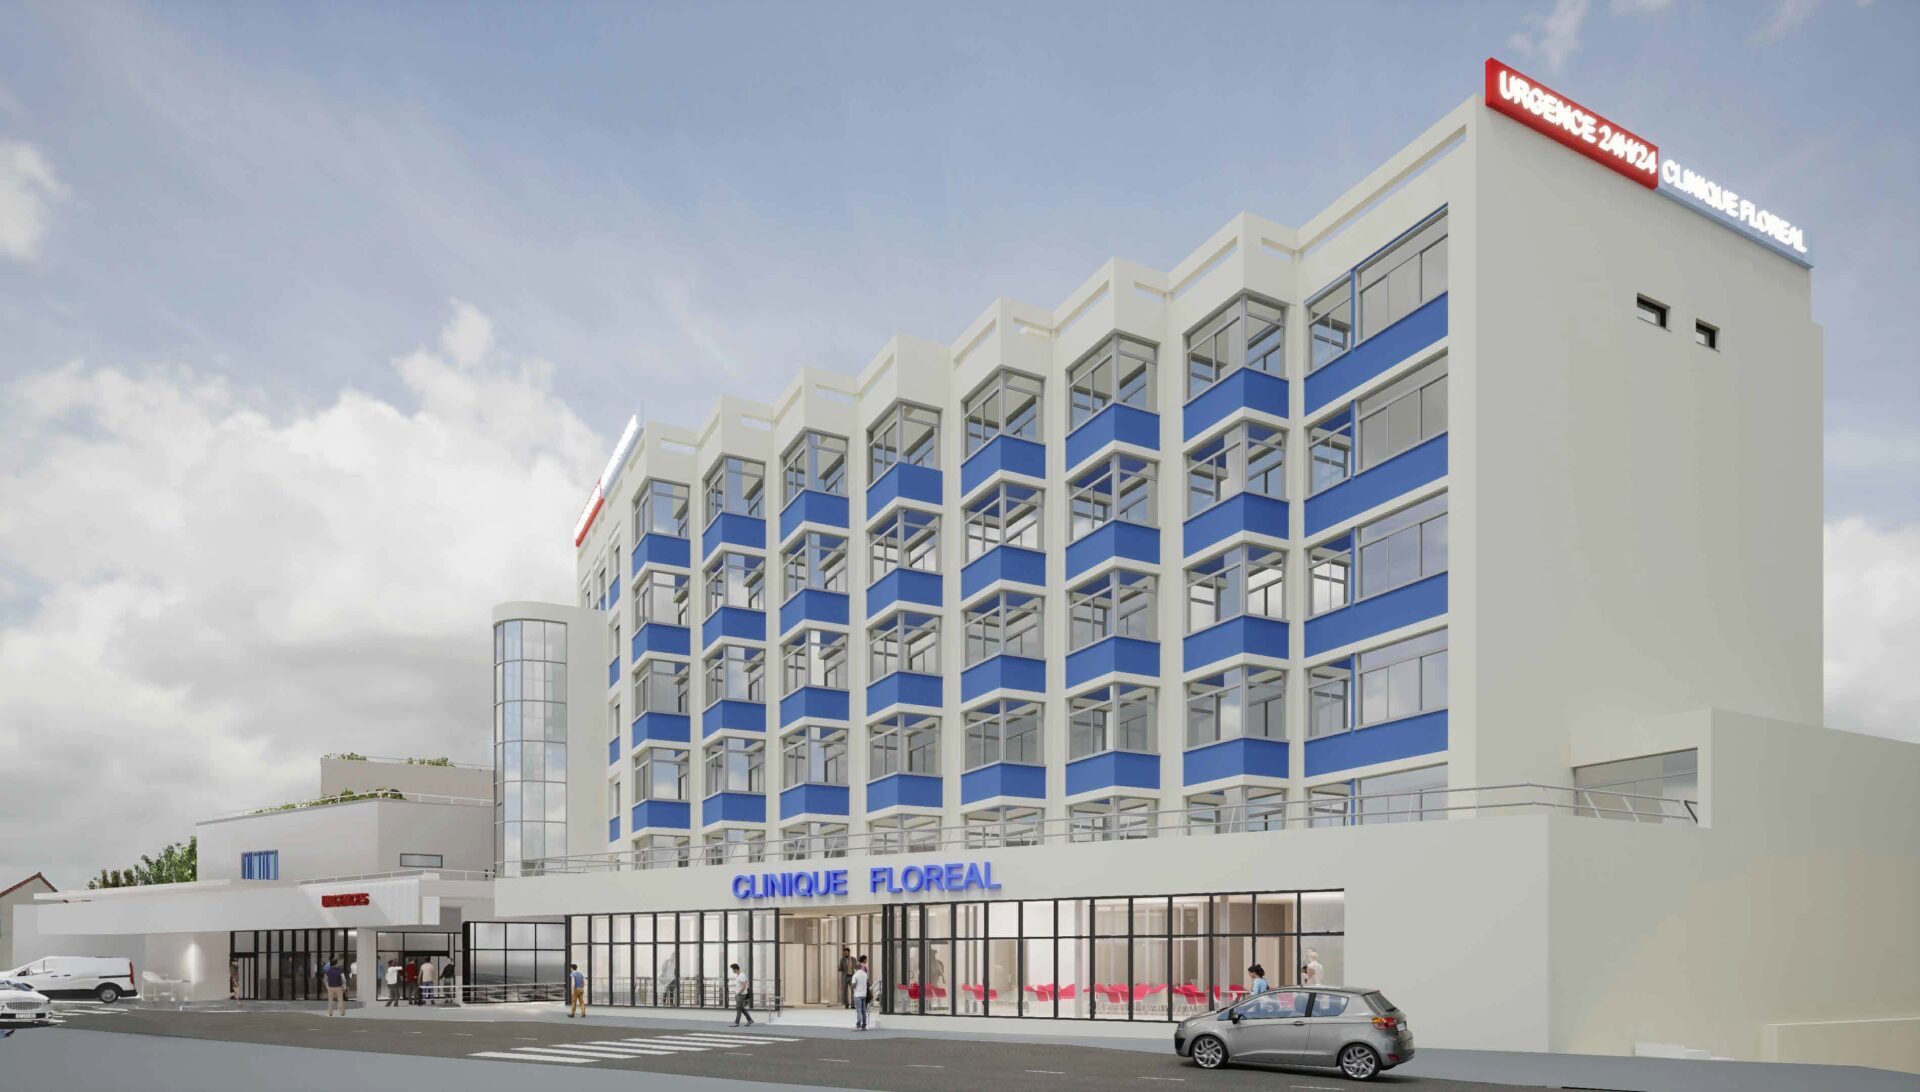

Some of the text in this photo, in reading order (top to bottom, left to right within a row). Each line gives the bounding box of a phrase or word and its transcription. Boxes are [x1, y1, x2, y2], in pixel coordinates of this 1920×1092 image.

[1499, 70, 1597, 144] URGENCE
[1661, 159, 1808, 253] CLINIQUE FLOREAL
[732, 861, 1002, 899] CLINIQUE FLOREAL
